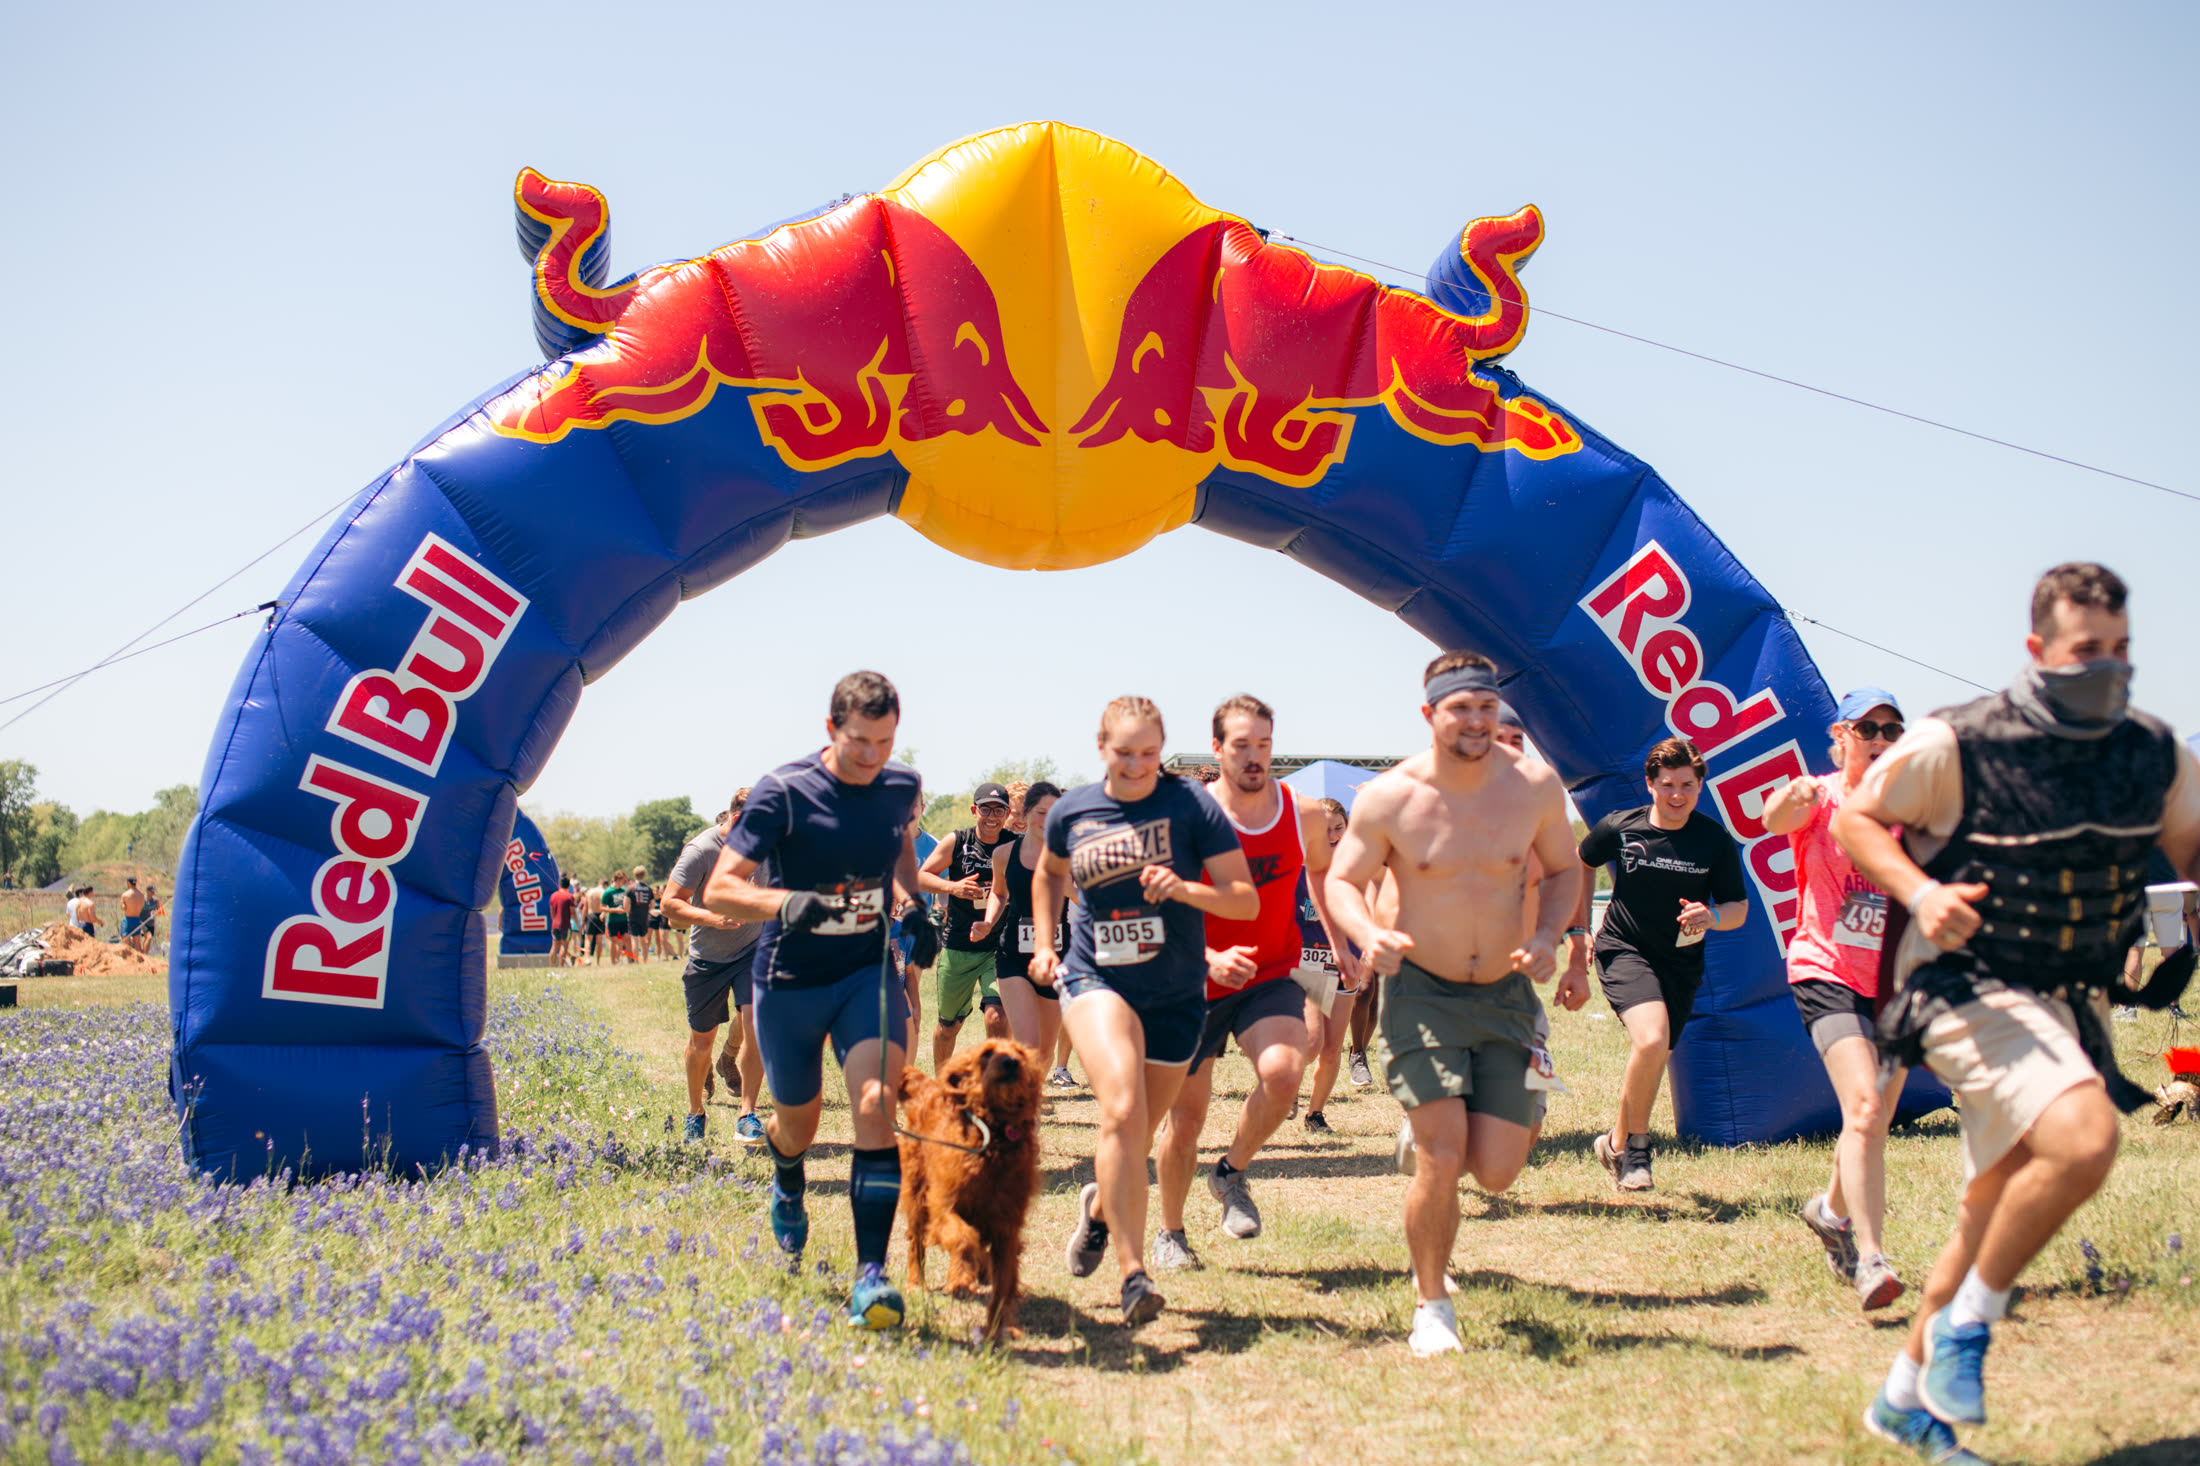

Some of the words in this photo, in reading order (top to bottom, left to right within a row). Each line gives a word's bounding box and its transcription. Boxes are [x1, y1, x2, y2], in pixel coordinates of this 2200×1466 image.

[332, 538, 525, 772] Bull
[1583, 544, 1782, 758] Red
[505, 838, 541, 889] Red
[1073, 822, 1169, 884] BRONZE
[1637, 858, 1688, 873] GLADIATOR
[267, 759, 425, 1004] Red
[517, 884, 548, 932] Bull
[1099, 920, 1155, 945] 3055
